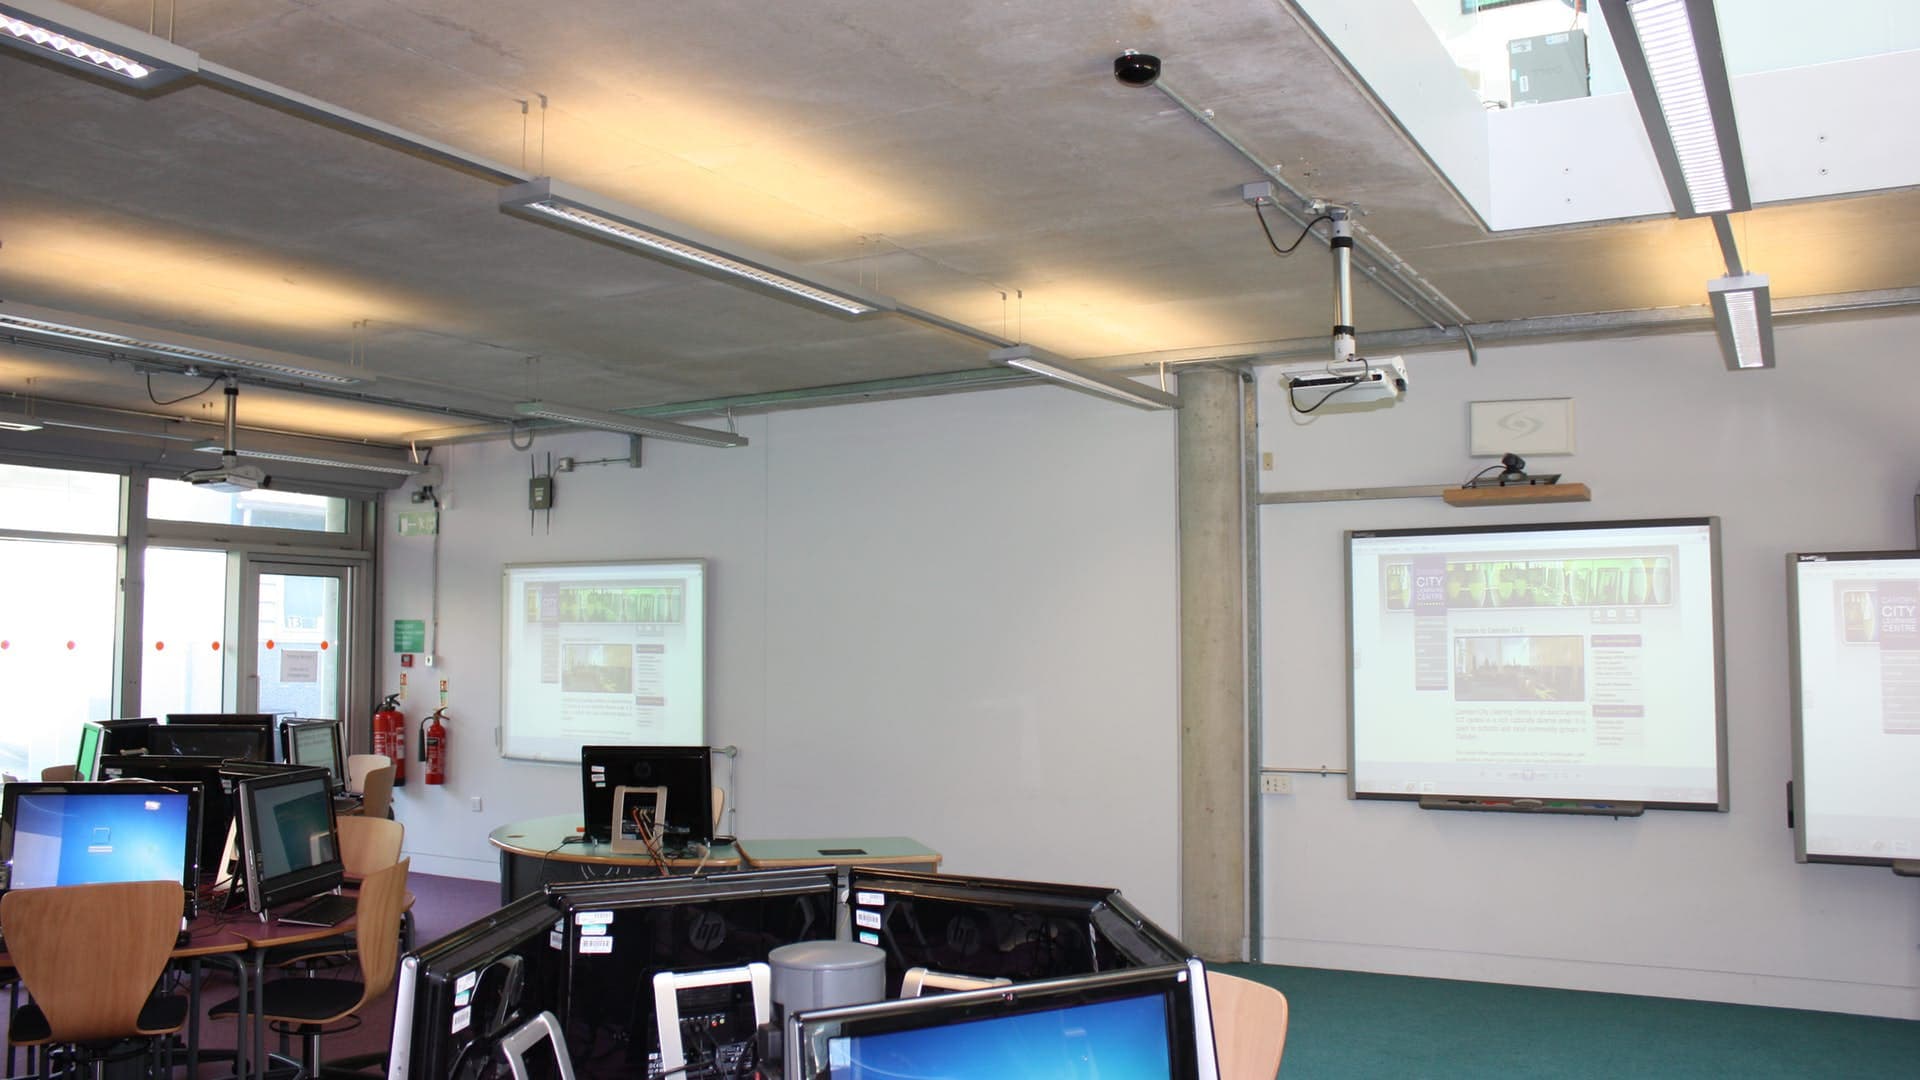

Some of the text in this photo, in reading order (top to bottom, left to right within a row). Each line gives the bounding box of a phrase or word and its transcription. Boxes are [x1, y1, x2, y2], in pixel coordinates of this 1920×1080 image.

[1416, 576, 1443, 588] CITY
[1882, 606, 1916, 617] CITY
[1882, 624, 1917, 632] CENTRE
[693, 912, 724, 950] hp
